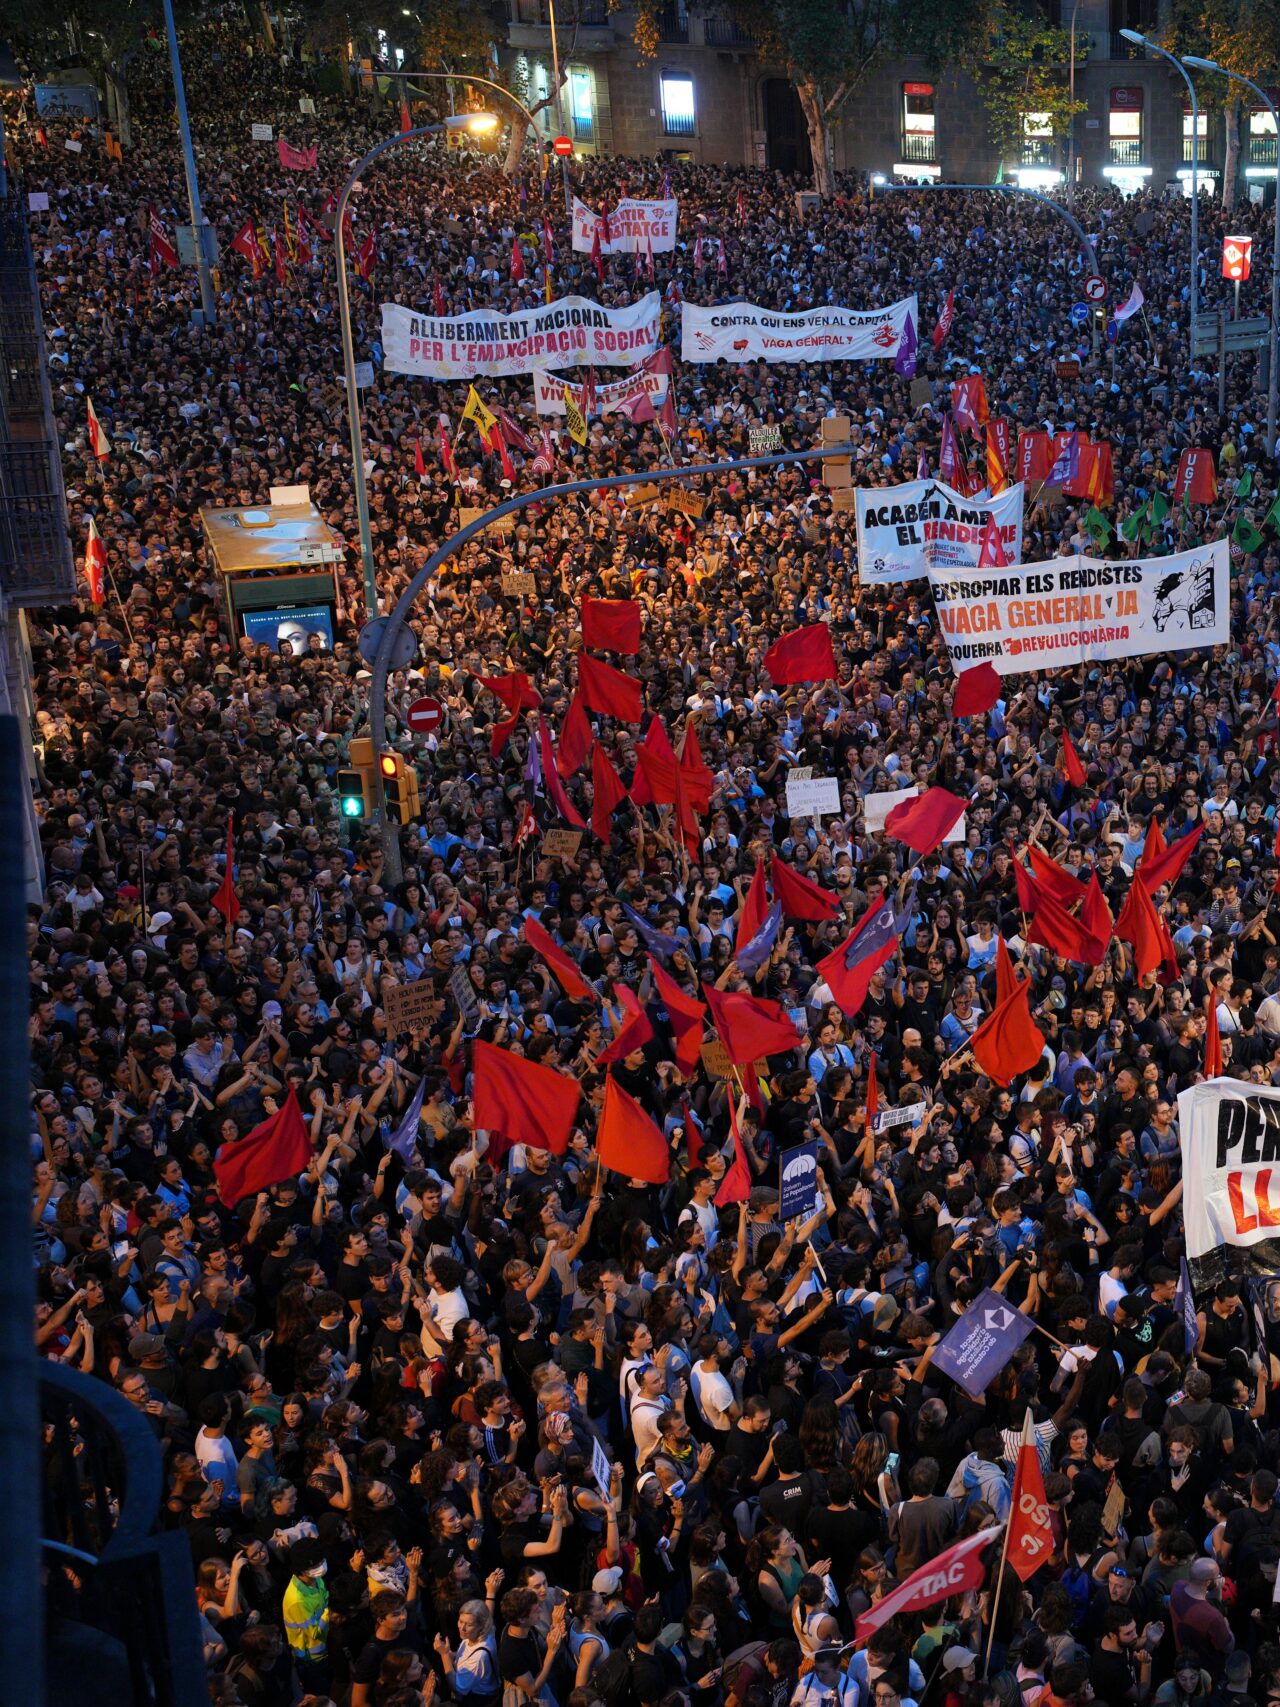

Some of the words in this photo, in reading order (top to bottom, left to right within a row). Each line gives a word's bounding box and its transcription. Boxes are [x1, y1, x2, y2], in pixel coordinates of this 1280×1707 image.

[409, 317, 529, 342] ALLIBERAMENT
[534, 308, 612, 333] NACIONAL
[711, 316, 758, 328] CONTRA
[761, 316, 780, 328] QUI
[783, 317, 805, 328] ENS
[808, 316, 828, 326] VEN
[831, 315, 846, 326] AL
[849, 313, 893, 326] CAPITAL
[409, 339, 443, 361] PER
[762, 337, 793, 348] VAGA
[796, 336, 844, 347] GENERAL
[896, 526, 921, 546] EL
[932, 577, 1021, 602] EXPROPIAR
[1027, 574, 1054, 593] ELS
[1060, 566, 1142, 589] RENDISTES
[940, 602, 1002, 634] VAGA
[1007, 594, 1105, 628] GENERAL
[1115, 590, 1138, 617] JA
